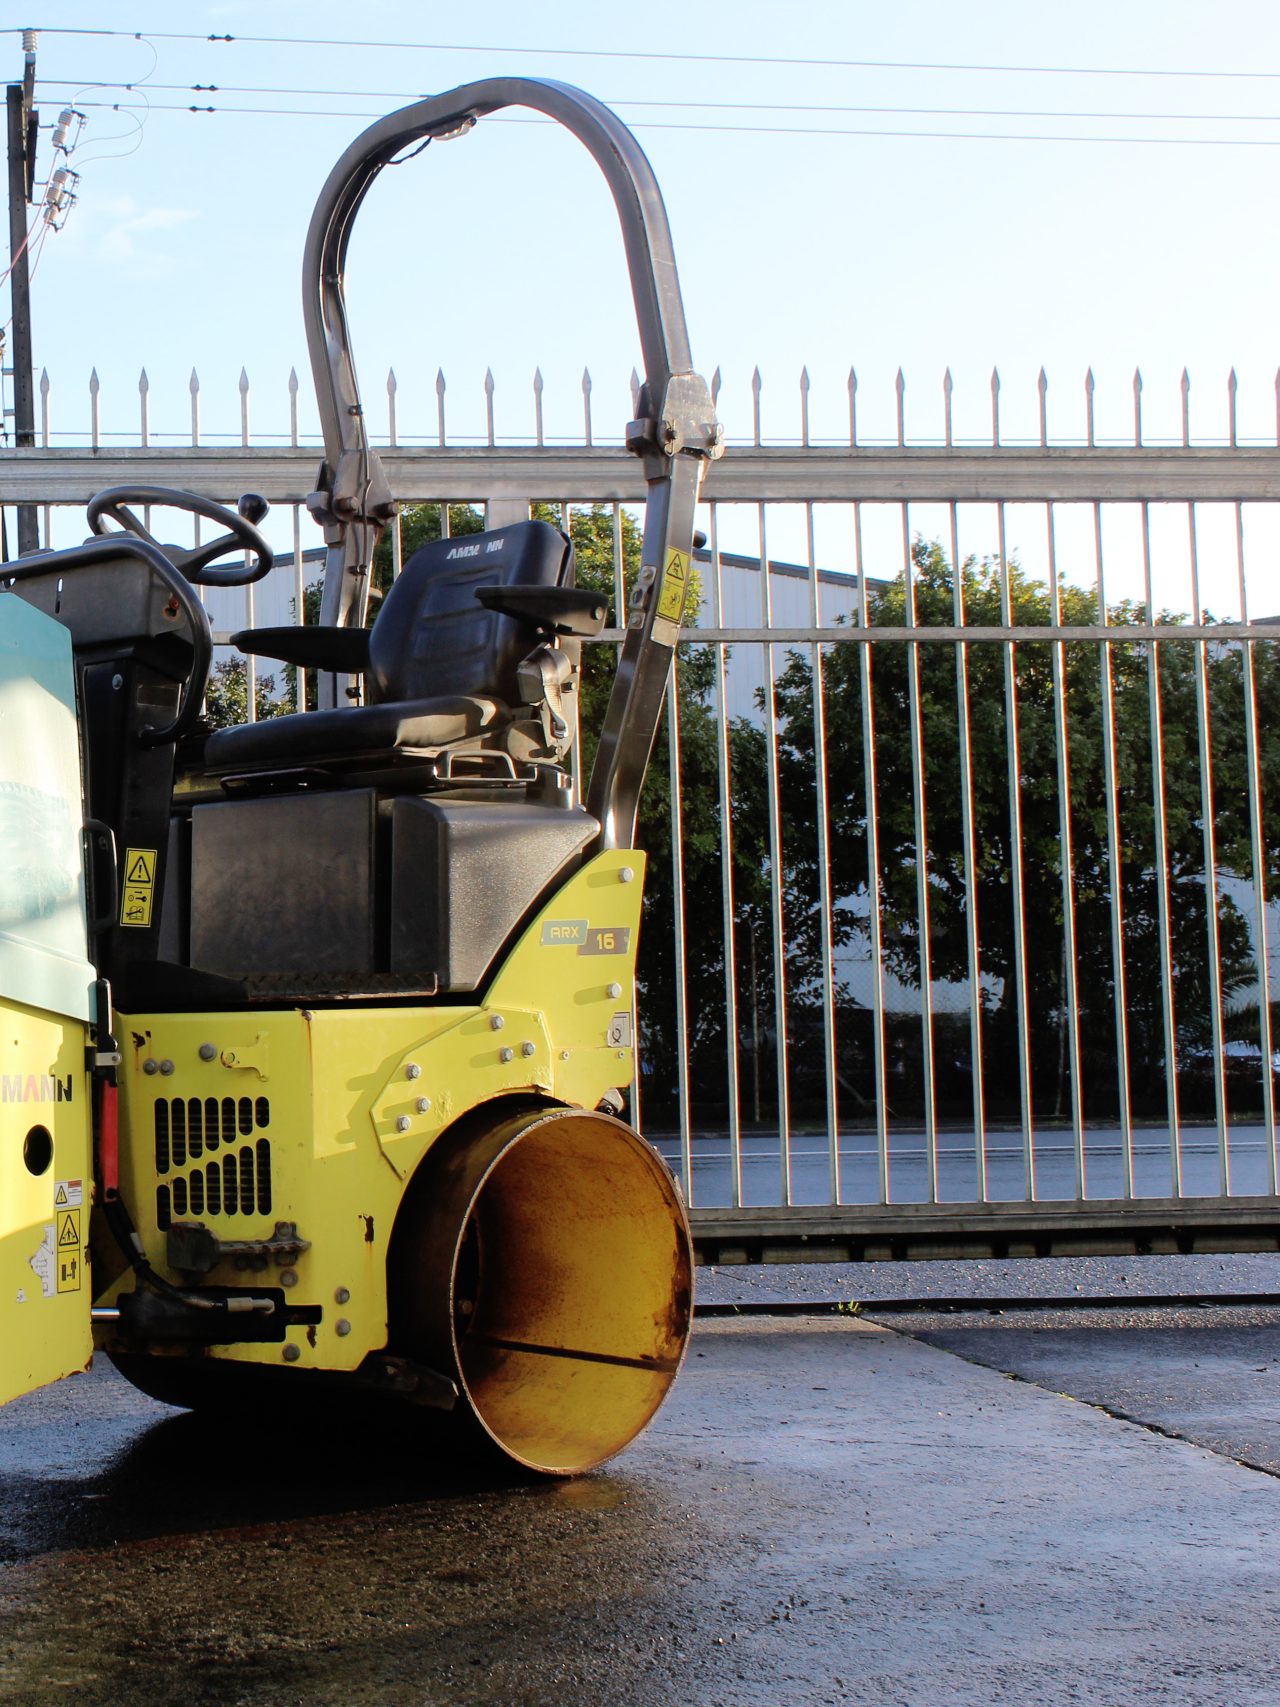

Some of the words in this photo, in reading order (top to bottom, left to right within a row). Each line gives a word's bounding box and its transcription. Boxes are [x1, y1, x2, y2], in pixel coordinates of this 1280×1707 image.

[446, 538, 505, 560] AMMNN
[550, 926, 580, 939] ARX
[596, 932, 616, 950] 16
